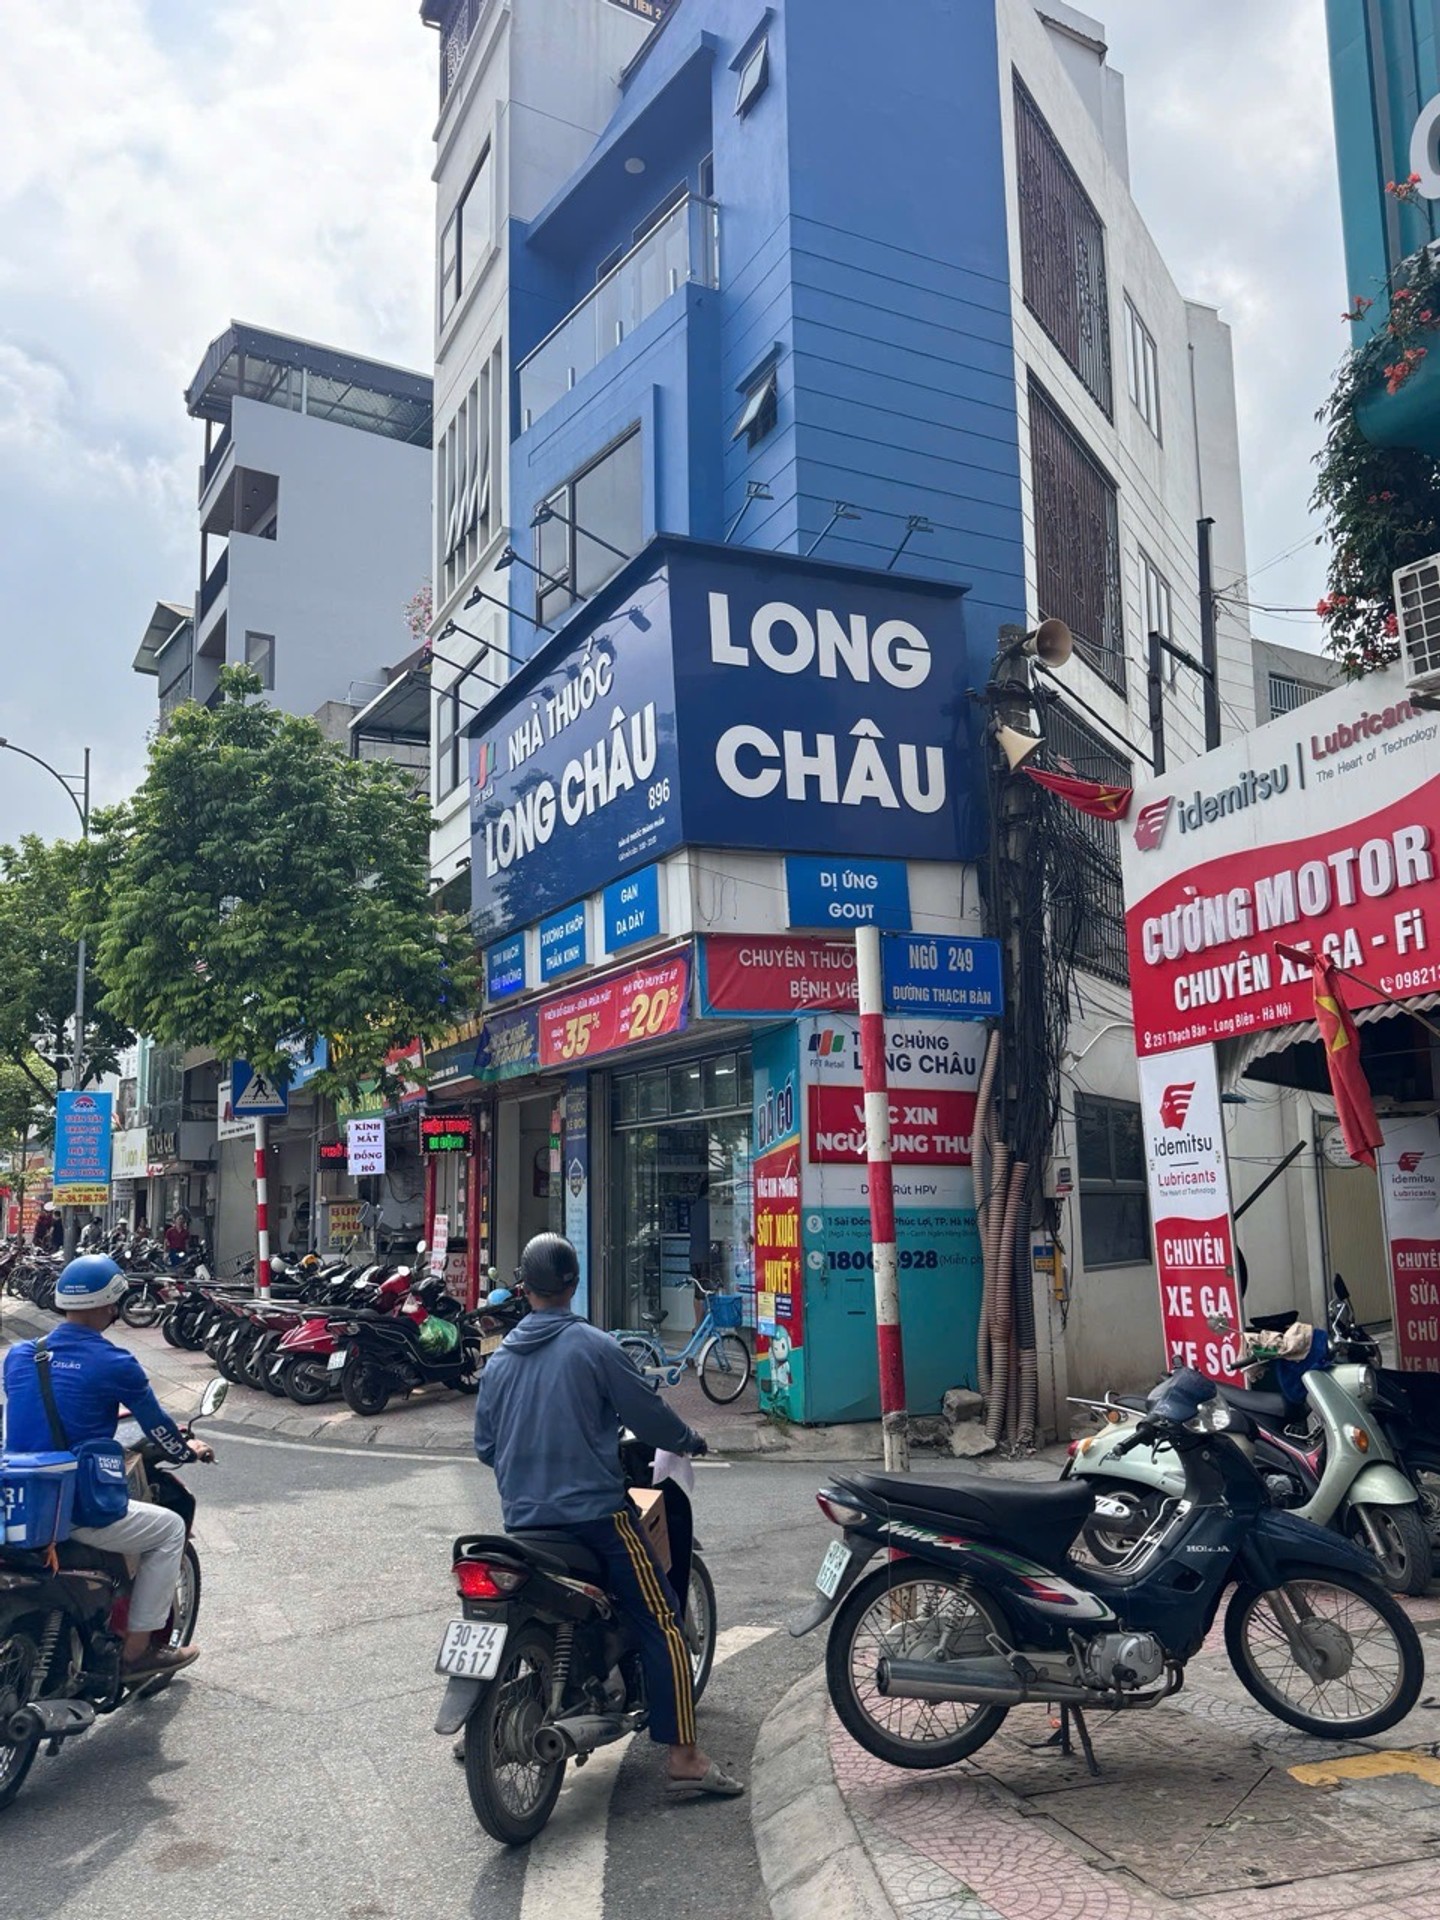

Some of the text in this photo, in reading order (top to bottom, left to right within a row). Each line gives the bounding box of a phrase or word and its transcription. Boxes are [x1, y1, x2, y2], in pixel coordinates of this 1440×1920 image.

[708, 592, 931, 689] LONG
[508, 636, 614, 772] NHÀ THUỐC
[715, 717, 947, 814] CHÂU
[1316, 724, 1438, 783] The Heart of Technology
[486, 701, 657, 879] LONG CHÂU
[648, 777, 670, 811] 896
[1177, 761, 1290, 835] idemitsu
[620, 883, 638, 903] GAN
[820, 869, 878, 892] DỊ ỨNG
[1142, 824, 1436, 966] CƯỜNG MOTOR
[616, 909, 645, 936] DẠ DÀY
[828, 902, 875, 919] GOUT
[739, 946, 805, 969] CHUYÊN
[909, 940, 974, 973] NGÕ 249
[1174, 951, 1271, 1012] CHUYÊN
[1322, 927, 1366, 971] GA
[1394, 908, 1428, 955] Fi
[790, 976, 860, 1004] BỆNH VIỆ
[892, 984, 991, 1006] ĐƯỜNG THẠCH BÀN
[629, 984, 679, 1040] 20%
[1153, 1002, 1292, 1047] 251 Thạch Bàn Long Biên Hà Nội
[562, 1011, 600, 1058] 35%
[892, 1030, 949, 1050] CHỦNG
[824, 1060, 845, 1068] Retail
[853, 1051, 976, 1076] LNG CHÂU
[757, 1073, 795, 1151] ĐÃ CÓ
[854, 1105, 938, 1126] VC XIN
[355, 1123, 381, 1131] KÍNH
[816, 1126, 864, 1151] NGỪ
[1153, 1132, 1213, 1157] idemitsu
[894, 1184, 937, 1196] Rút HPV
[1157, 1170, 1217, 1187] Lubricants
[1392, 1173, 1435, 1184] idemitsu
[1393, 1190, 1437, 1198] Lubricants
[757, 1206, 798, 1247] SỐT XUẤT
[834, 1216, 849, 1226] Sài
[851, 1216, 871, 1226] Đồn
[894, 1216, 915, 1227] Phúc
[950, 1217, 962, 1226] Hà
[964, 1217, 977, 1227] Nộ
[897, 1251, 938, 1269] 928
[970, 1255, 983, 1268] ph
[1163, 1231, 1225, 1266] CHUYÊN
[1397, 1248, 1440, 1269] CHUYÊ
[765, 1253, 792, 1294] HUYẾT
[1166, 1285, 1233, 1319] XE GA
[1410, 1278, 1440, 1306] SỬA
[51, 1360, 82, 1370] Otsuka
[1205, 1328, 1238, 1378] SỐ
[445, 1648, 492, 1674] 7617
